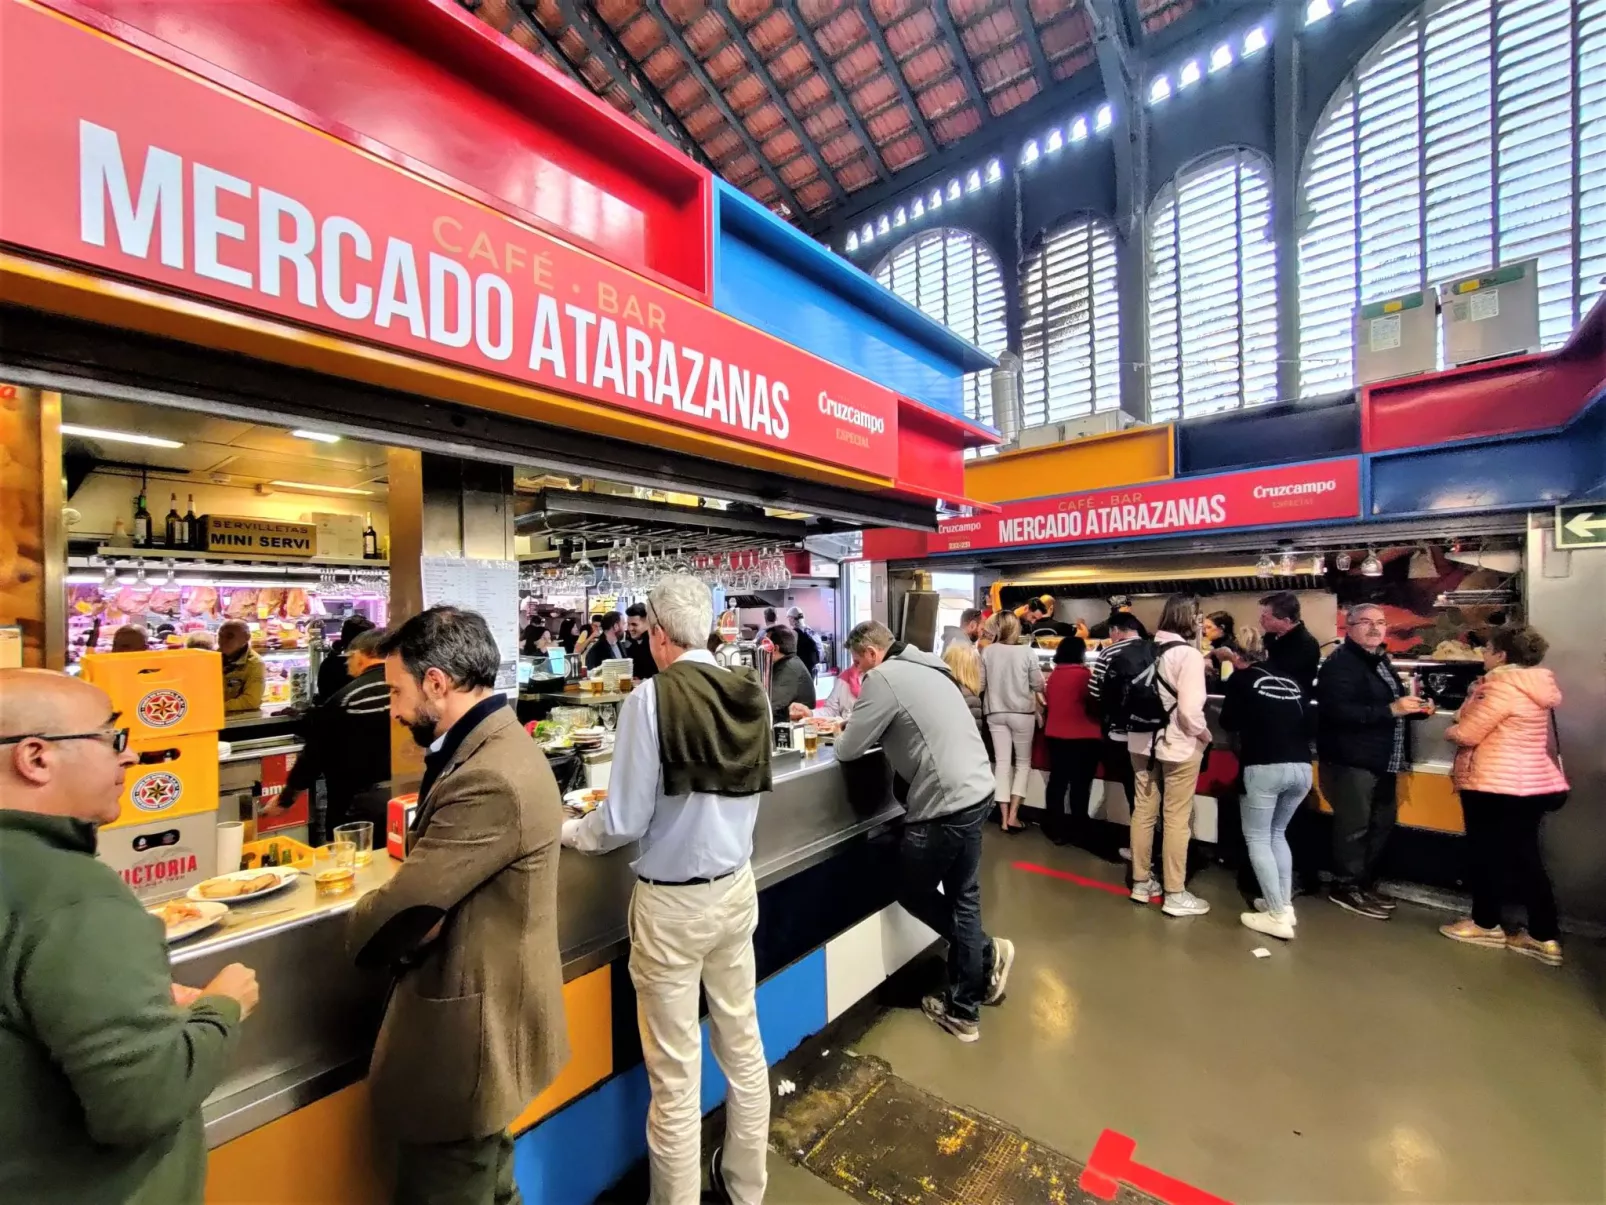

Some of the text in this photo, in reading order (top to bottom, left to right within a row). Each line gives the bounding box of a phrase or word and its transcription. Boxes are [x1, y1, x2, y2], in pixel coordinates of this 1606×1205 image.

[80, 119, 790, 440] MERCADO ATARAZANAS
[432, 216, 666, 333] CAFÉ BAR
[818, 390, 884, 435] Cruzcampo
[1253, 479, 1336, 499] Cruzcampo
[1058, 492, 1143, 512] CAFÉ BAR
[213, 520, 309, 534] SERVILLETAS
[938, 522, 981, 534] Cruzcampo
[999, 494, 1227, 543] MERCADO ATARAZANAS
[211, 533, 310, 550] MINI SERVI
